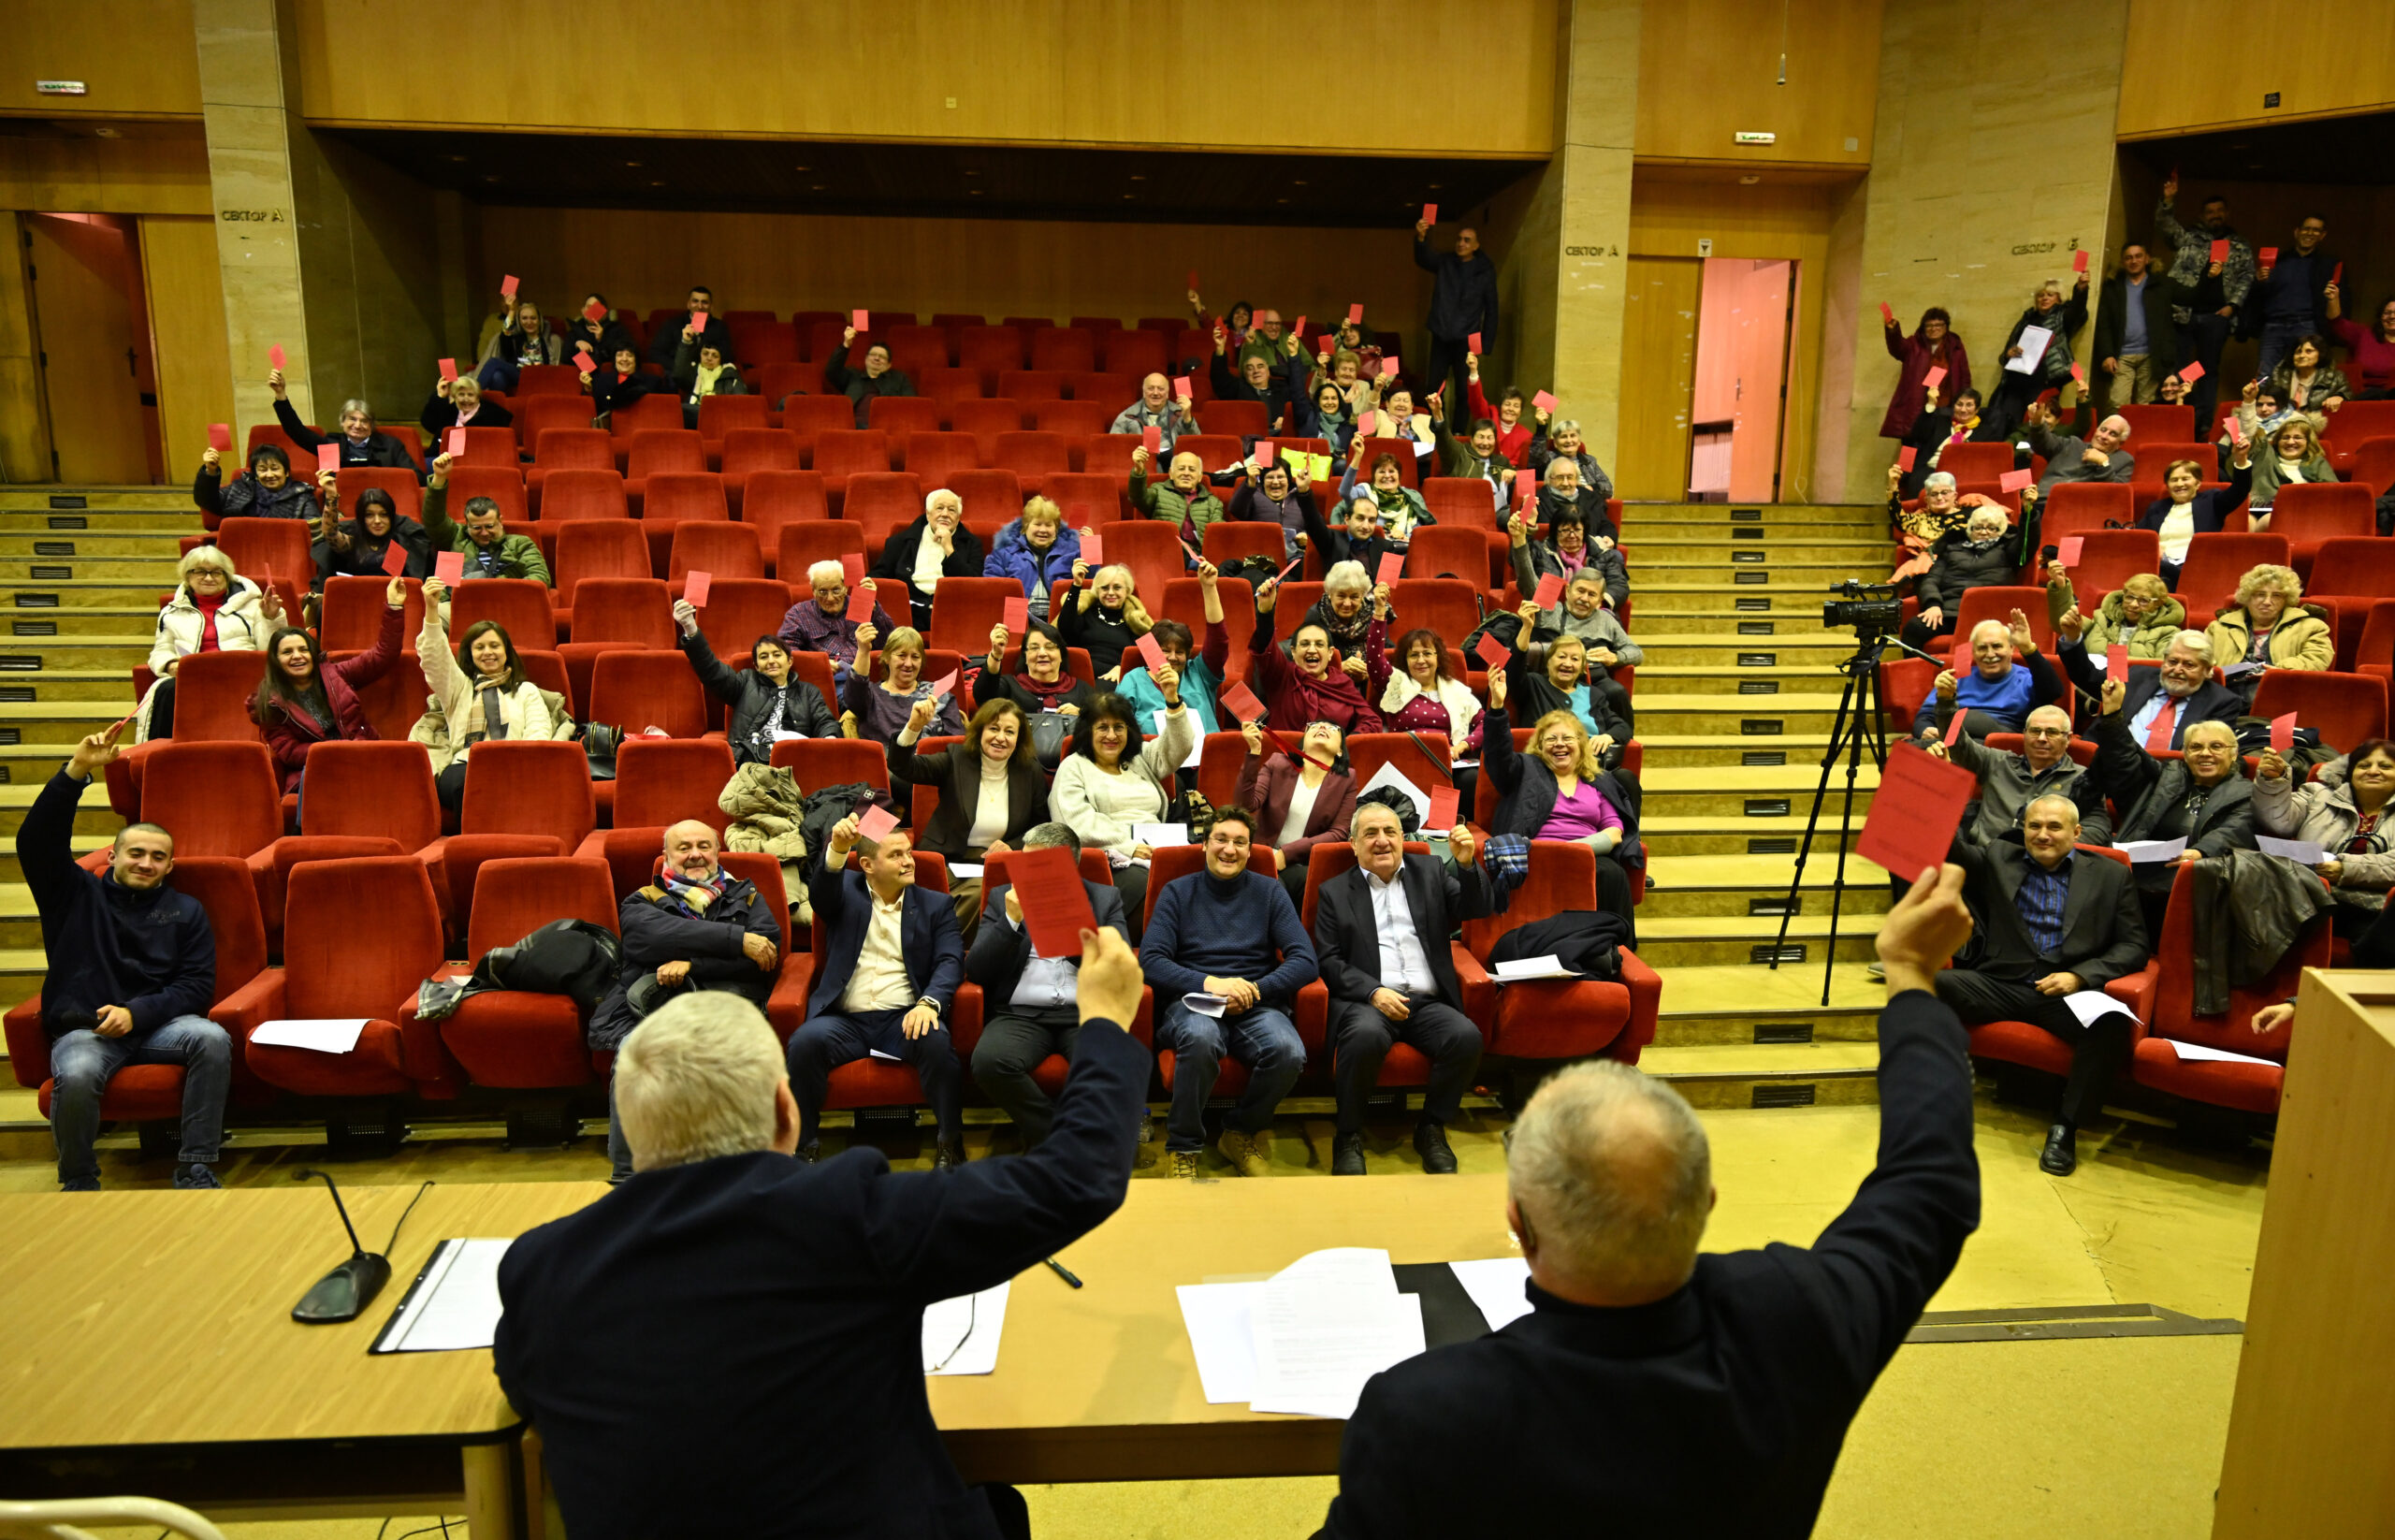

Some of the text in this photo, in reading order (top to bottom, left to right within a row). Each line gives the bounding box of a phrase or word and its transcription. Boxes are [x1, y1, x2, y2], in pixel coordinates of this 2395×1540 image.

[222, 209, 284, 222] СЕКТОР А
[1565, 244, 1618, 256] СЕКТОР А
